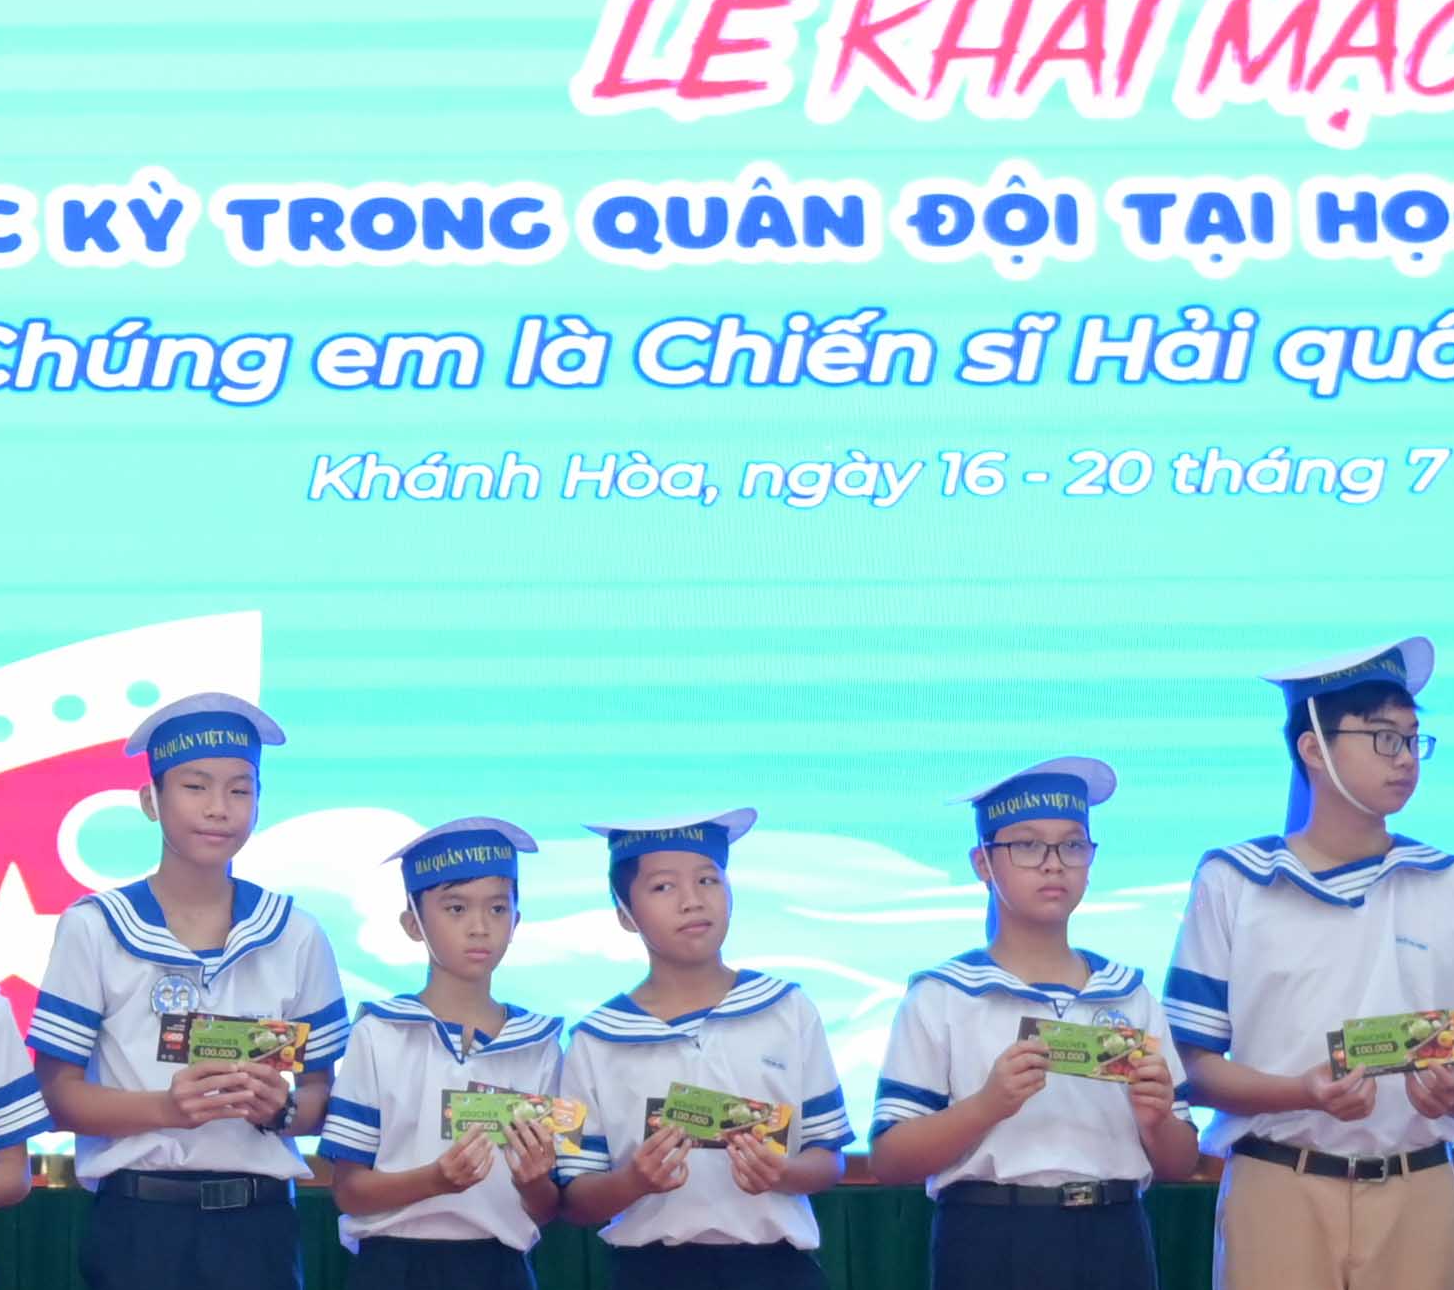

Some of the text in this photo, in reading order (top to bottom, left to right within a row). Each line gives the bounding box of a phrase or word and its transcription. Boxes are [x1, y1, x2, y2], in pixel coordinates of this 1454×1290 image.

[60, 178, 186, 254] KỲ
[225, 195, 550, 252] TRONG
[592, 175, 867, 255] QUÂN
[905, 174, 1080, 266] ĐỘI
[1122, 190, 1277, 264] TẠI
[315, 331, 484, 390] em
[508, 315, 612, 390] là
[634, 306, 937, 389] Chiến
[960, 311, 1060, 387] sĩ
[1074, 306, 1264, 387] Hải
[307, 451, 542, 503] Khánh
[562, 452, 722, 508] Hòa,
[740, 447, 922, 510] ngày
[938, 448, 1007, 497] 16
[1023, 471, 1050, 486] -
[1066, 448, 1156, 495] 20
[1170, 444, 1388, 505] tháng
[1405, 446, 1453, 495] 7
[196, 727, 225, 749] VIỆT
[227, 729, 249, 748] NAM
[1006, 792, 1040, 815] QUÂN
[1042, 791, 1071, 810] VIỆT
[464, 844, 493, 865] VIỆT
